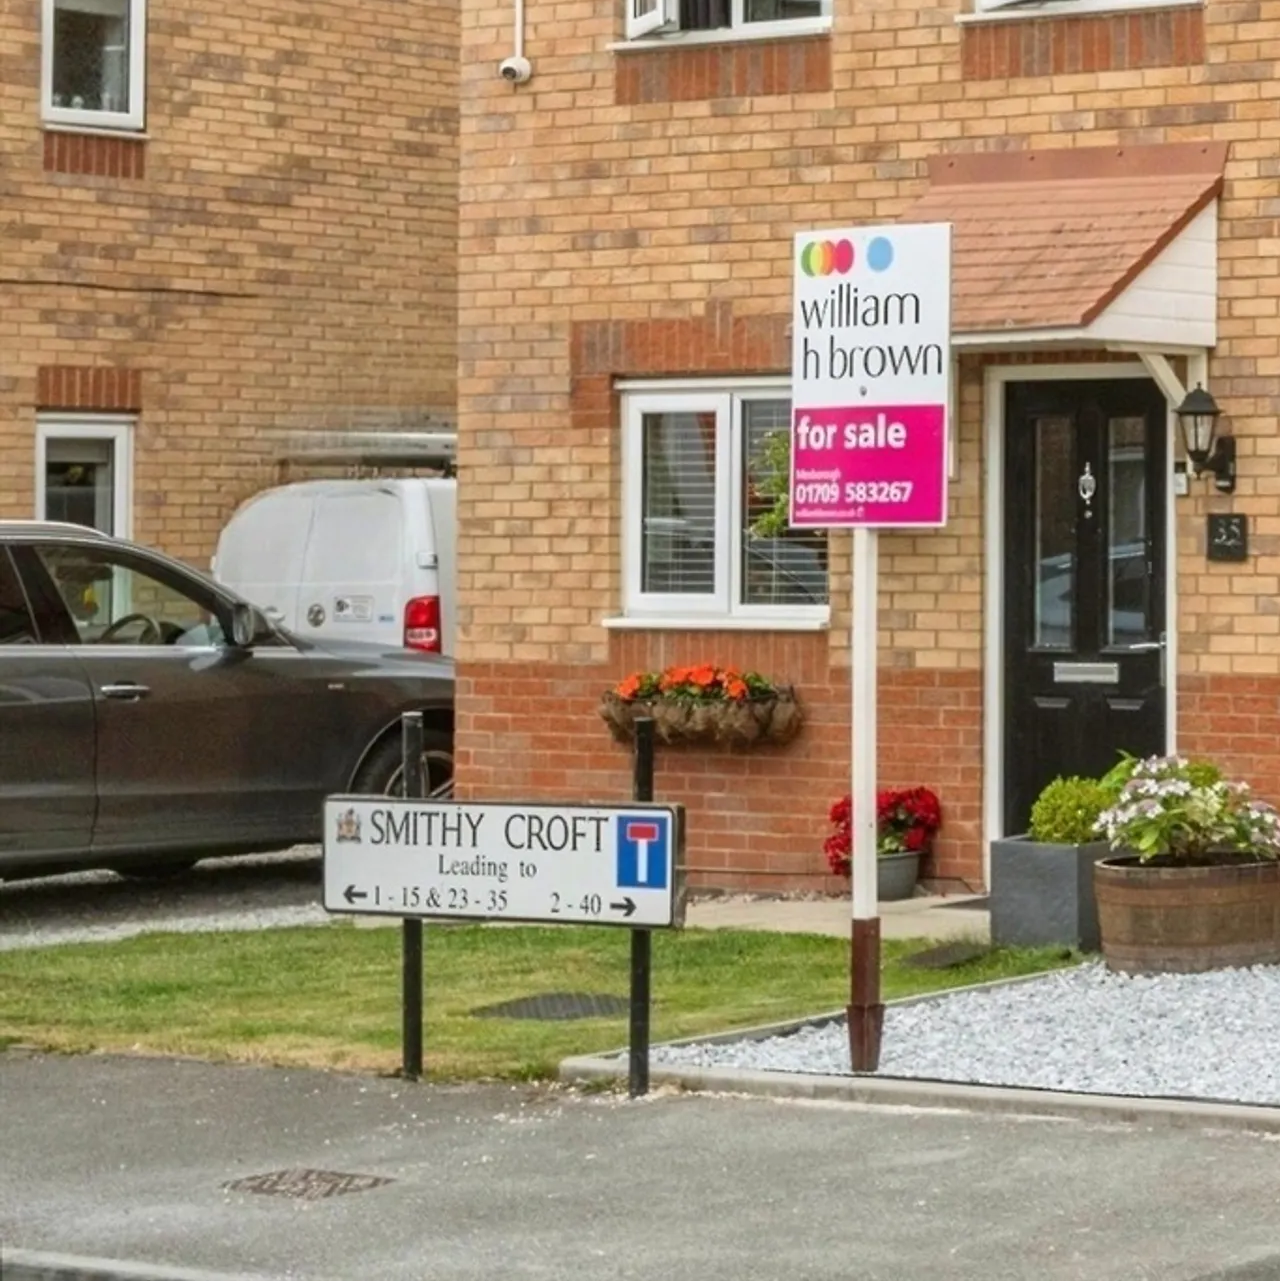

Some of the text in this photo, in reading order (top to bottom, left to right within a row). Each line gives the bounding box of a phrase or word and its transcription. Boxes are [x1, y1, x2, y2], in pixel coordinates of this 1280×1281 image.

[800, 282, 921, 329] william
[802, 335, 943, 380] h brown
[797, 414, 907, 451] for sale
[795, 481, 913, 504] 01709 583267
[370, 809, 609, 852] SMITHY CROFT
[438, 854, 537, 882] Leading to
[374, 886, 381, 905] 1
[402, 887, 421, 907] 15
[425, 888, 441, 908] &
[448, 889, 468, 909] 23
[487, 890, 508, 911] 35
[550, 893, 560, 914] 2
[579, 895, 602, 915] 40
